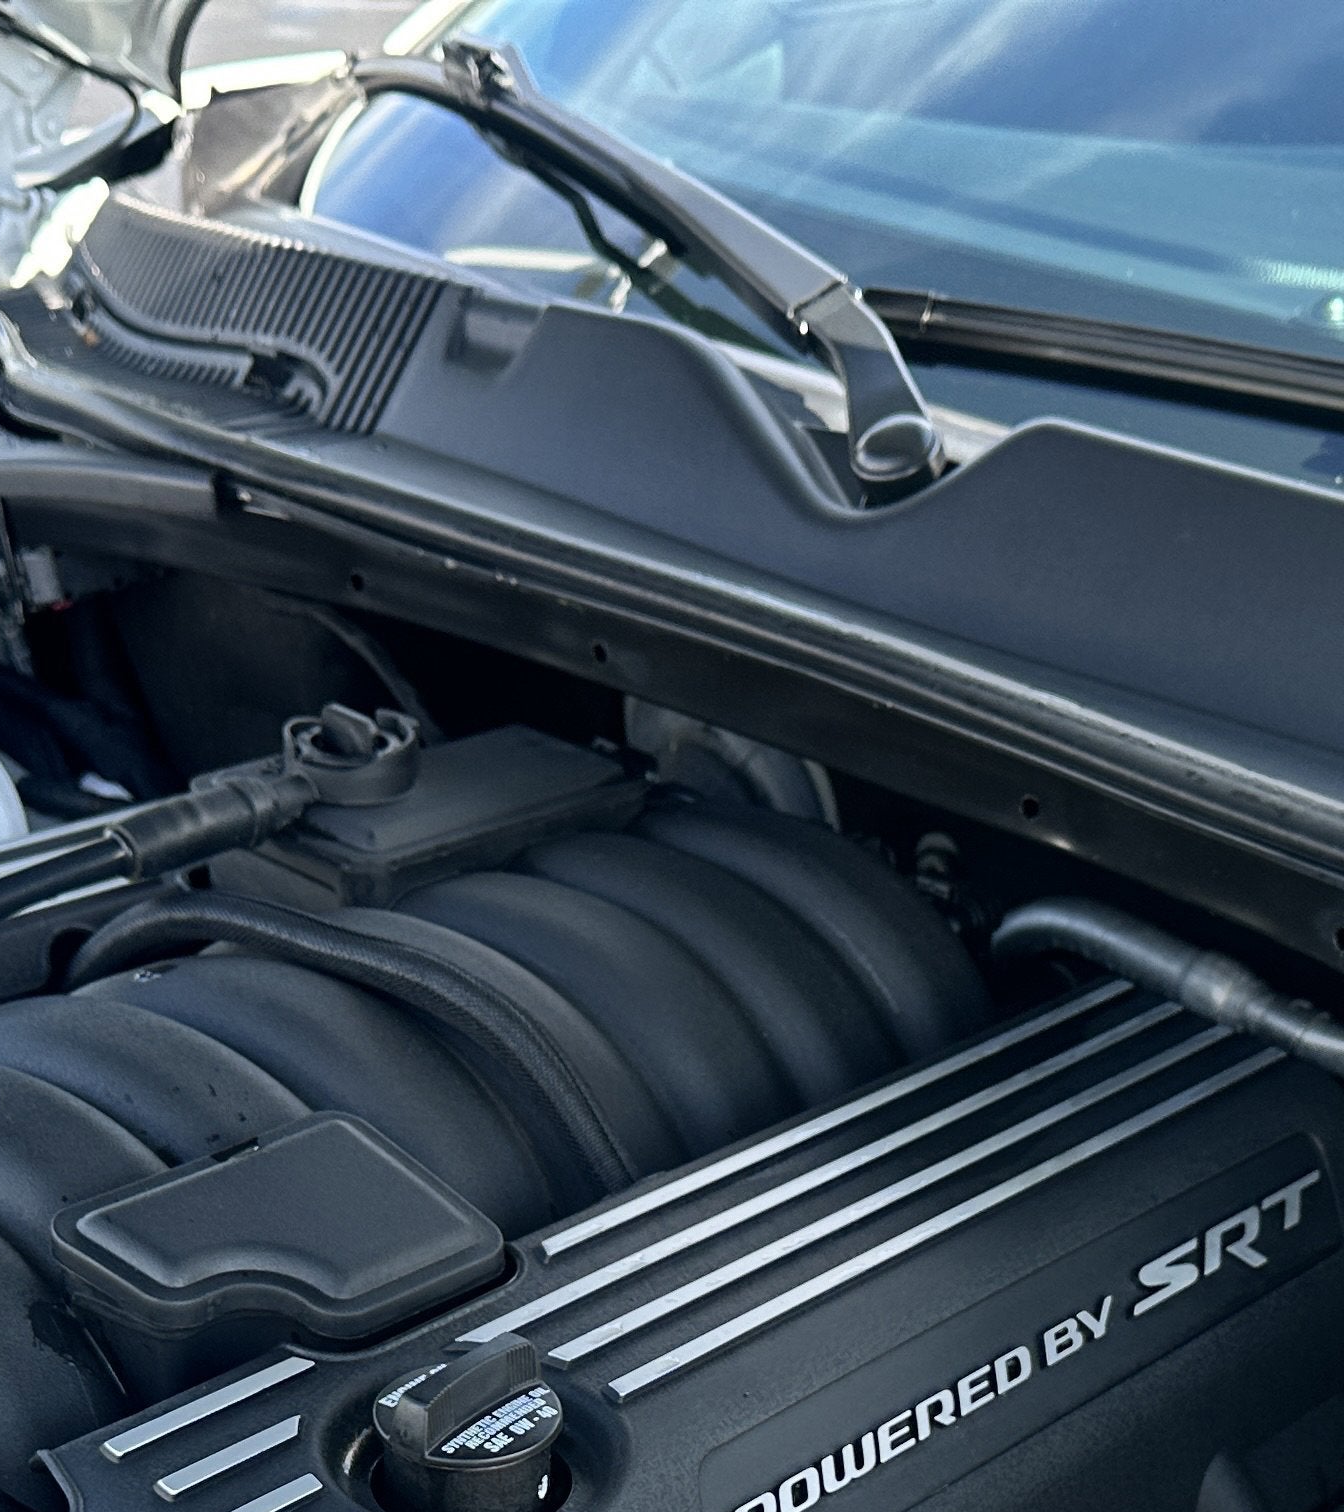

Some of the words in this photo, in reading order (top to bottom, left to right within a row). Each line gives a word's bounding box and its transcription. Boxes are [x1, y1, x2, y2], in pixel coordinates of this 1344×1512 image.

[1045, 1295, 1113, 1367] BY
[1132, 1168, 1322, 1317] SRT
[440, 1415, 497, 1454] SYNTHETIC
[491, 1394, 530, 1418] ENGINE
[528, 1386, 551, 1398] OIL
[464, 1397, 547, 1450] RECOMMENDED
[483, 1431, 515, 1454] SAE
